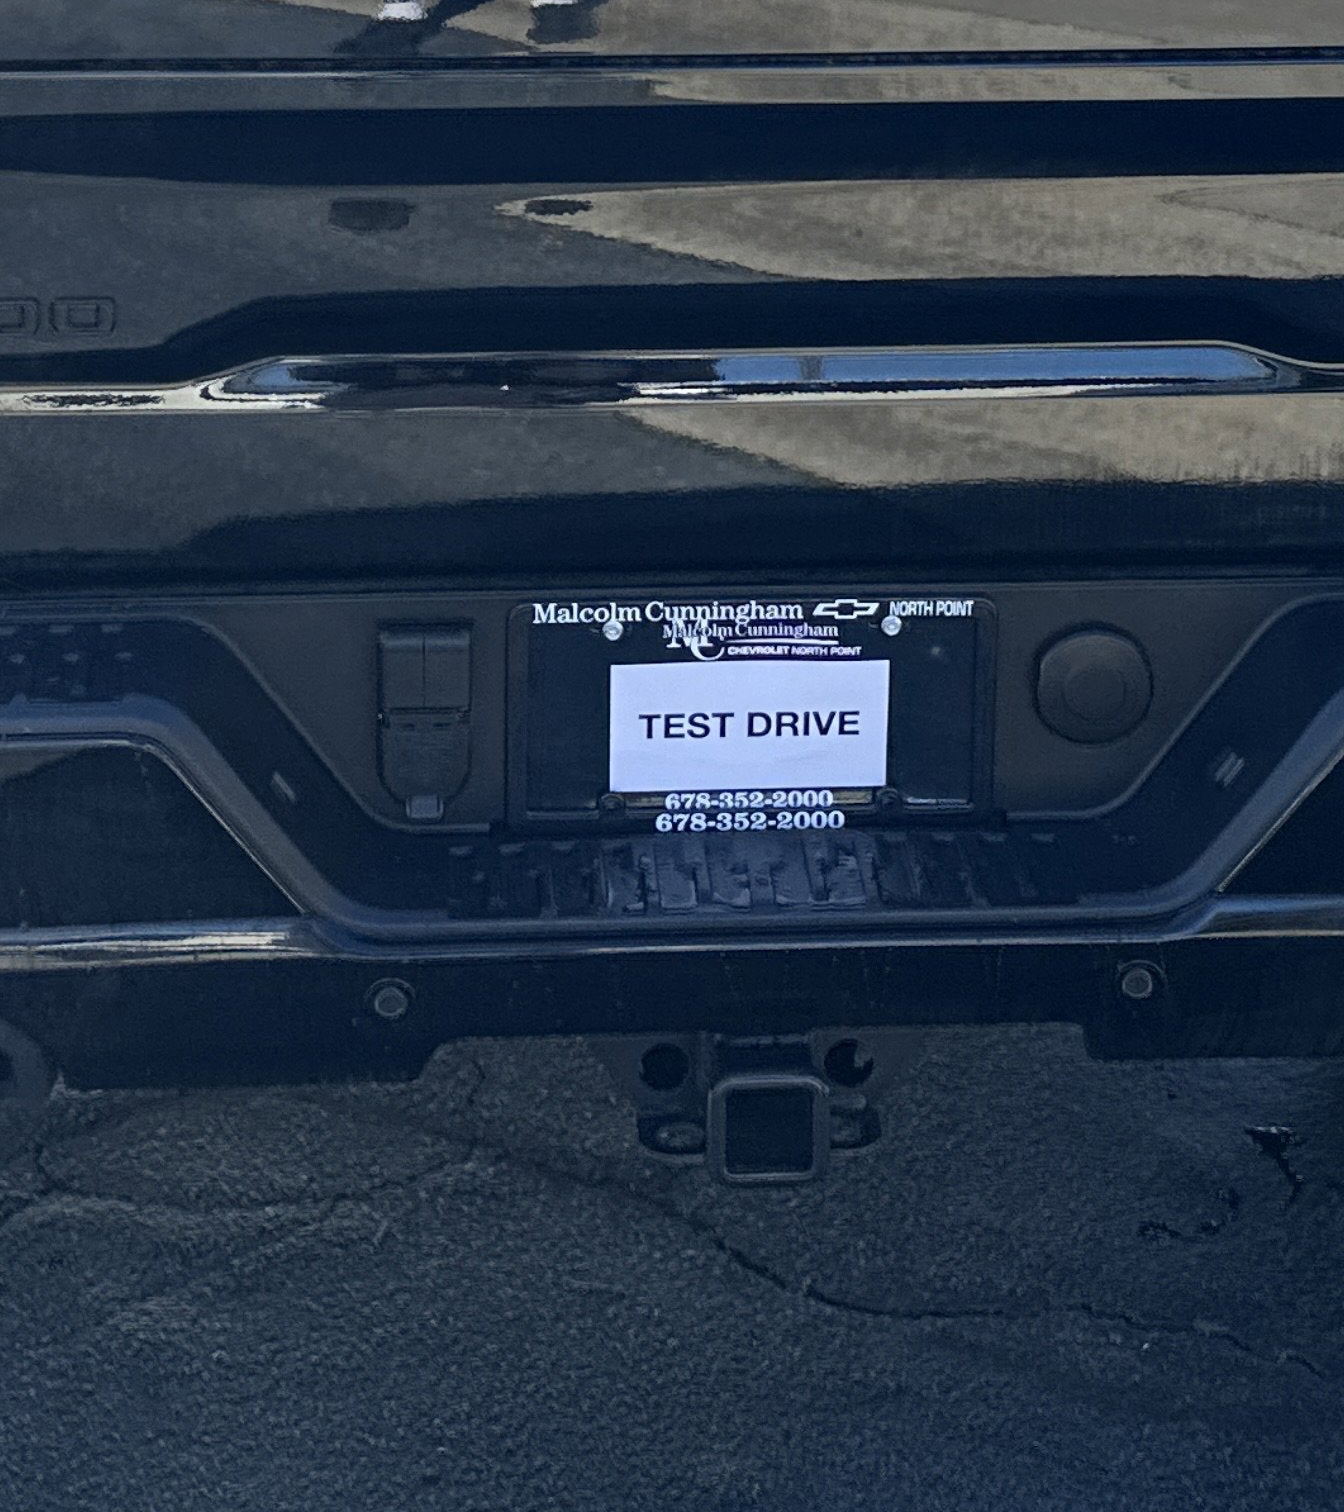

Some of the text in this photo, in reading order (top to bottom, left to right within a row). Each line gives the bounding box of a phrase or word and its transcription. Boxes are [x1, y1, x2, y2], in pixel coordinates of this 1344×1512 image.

[532, 600, 974, 625] Malcolm Cunningham NORTH POINT
[662, 621, 839, 641] Malcolm Cunningham
[727, 645, 862, 656] CHEVROLET NORTH POINT
[638, 710, 861, 739] TEST DRIVE
[664, 789, 834, 811] 678-352-2000
[655, 810, 845, 833] 678-352-2000
